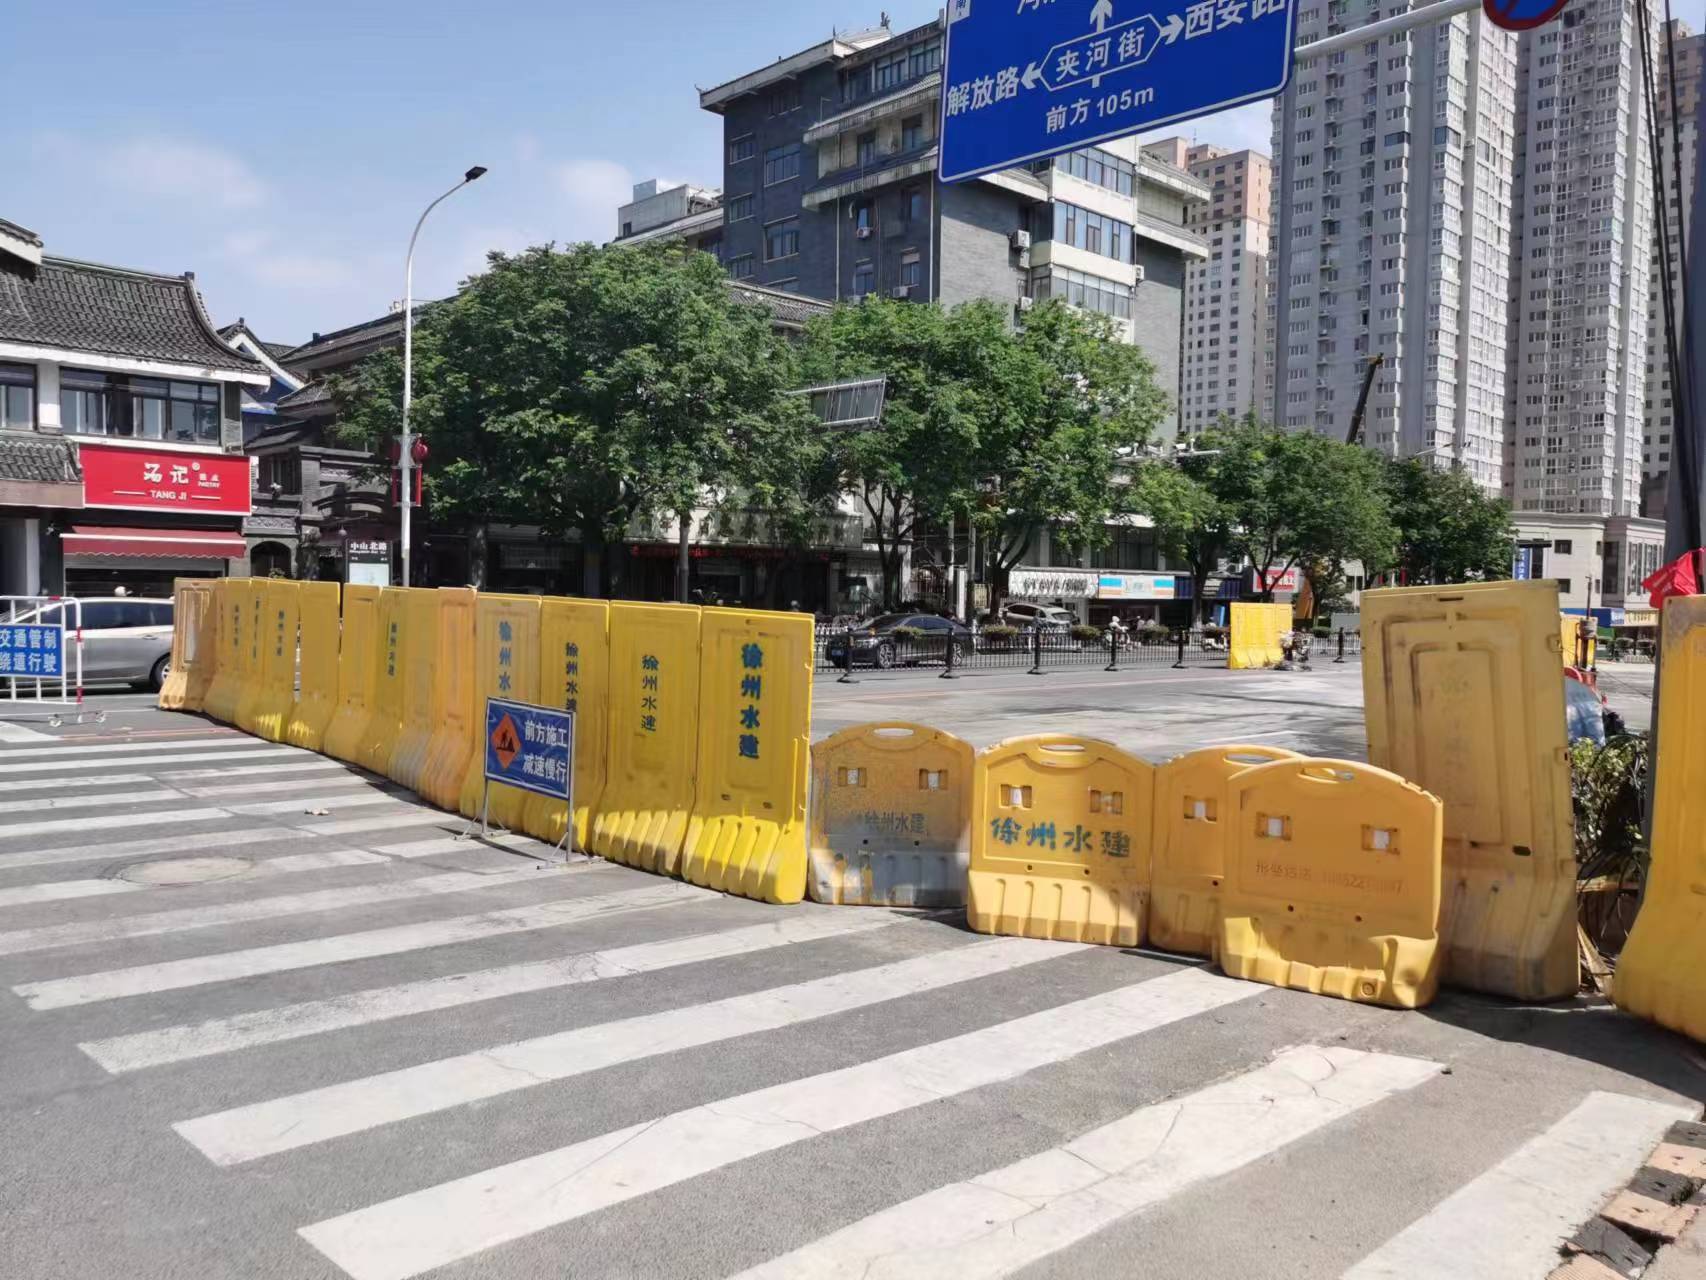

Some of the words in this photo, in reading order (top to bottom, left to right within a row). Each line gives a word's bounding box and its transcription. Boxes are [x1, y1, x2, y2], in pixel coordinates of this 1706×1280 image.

[1056, 26, 1145, 82] 夹河街
[946, 66, 1020, 117] 解放路
[149, 490, 176, 500] TANG
[178, 491, 187, 501] JI
[0, 628, 57, 649] 交通管制
[524, 719, 568, 748] 前方施工
[522, 752, 567, 783] 减速慢行
